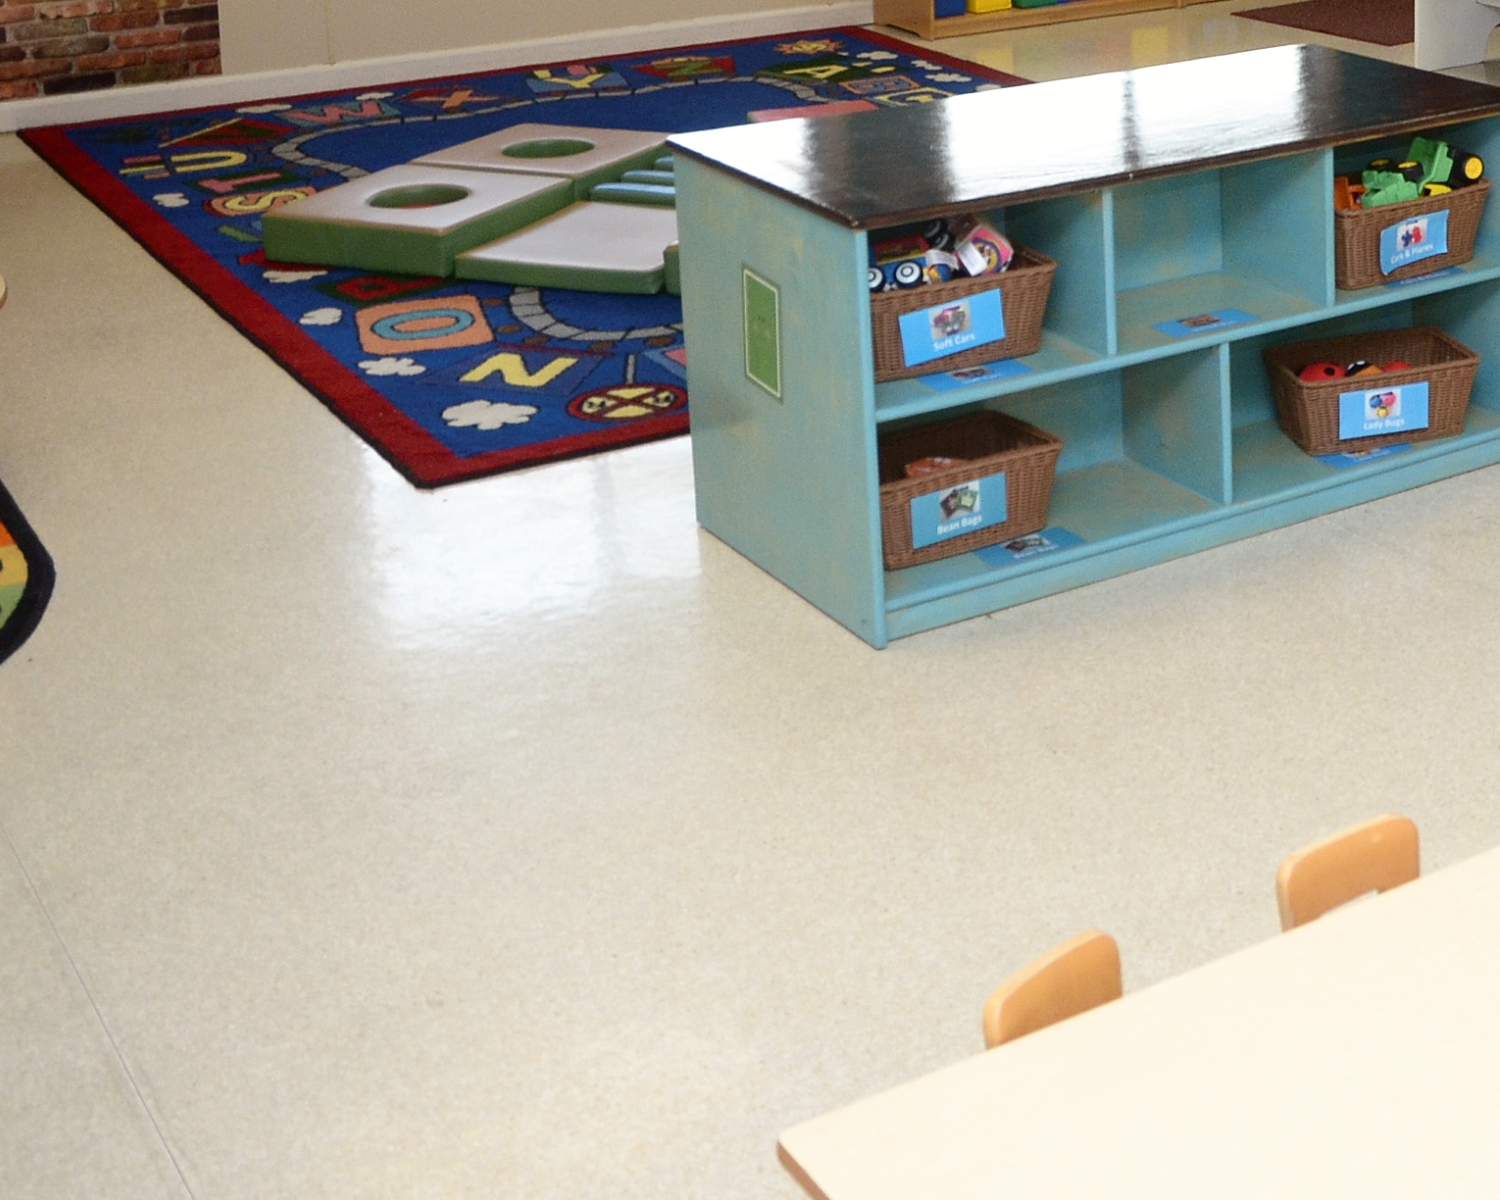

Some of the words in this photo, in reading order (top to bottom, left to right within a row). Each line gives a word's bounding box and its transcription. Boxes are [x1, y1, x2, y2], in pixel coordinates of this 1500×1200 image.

[372, 308, 474, 340] O
[934, 338, 954, 352] Soft
[954, 333, 975, 345] Cars
[460, 352, 580, 387] N
[1364, 421, 1383, 430] Lady
[1385, 419, 1404, 428] Bugs
[937, 522, 960, 534] Bean
[961, 515, 982, 528] Bags
